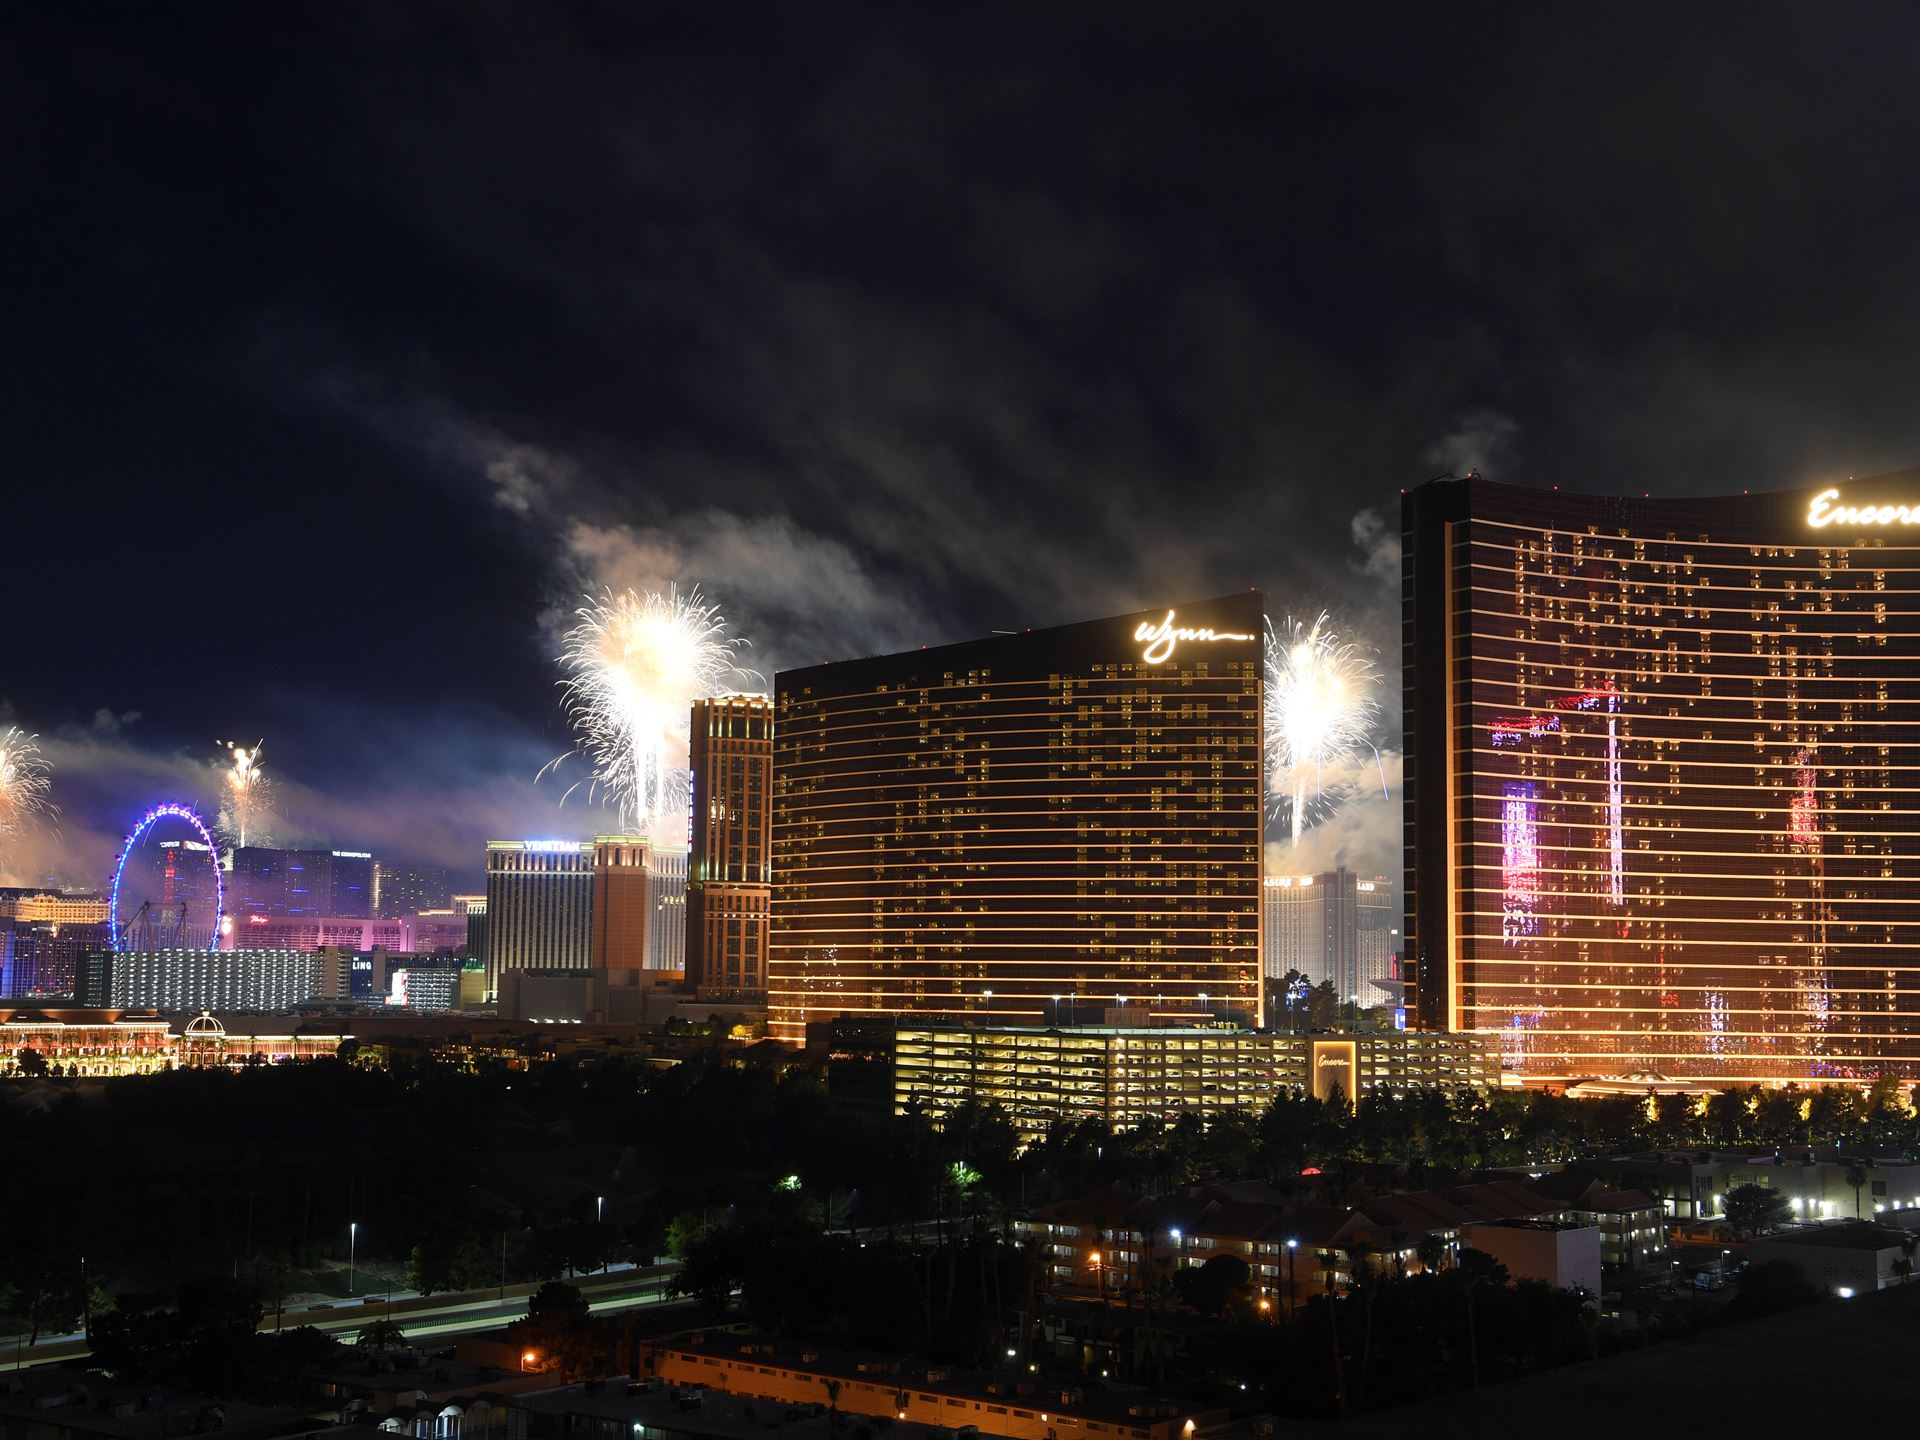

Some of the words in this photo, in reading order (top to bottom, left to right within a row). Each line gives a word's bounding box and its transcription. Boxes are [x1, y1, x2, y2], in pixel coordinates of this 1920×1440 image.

[523, 840, 580, 851] VENETIAN
[1356, 882, 1375, 891] LAND
[352, 961, 372, 970] LINQ
[1317, 1054, 1351, 1068] Encore
